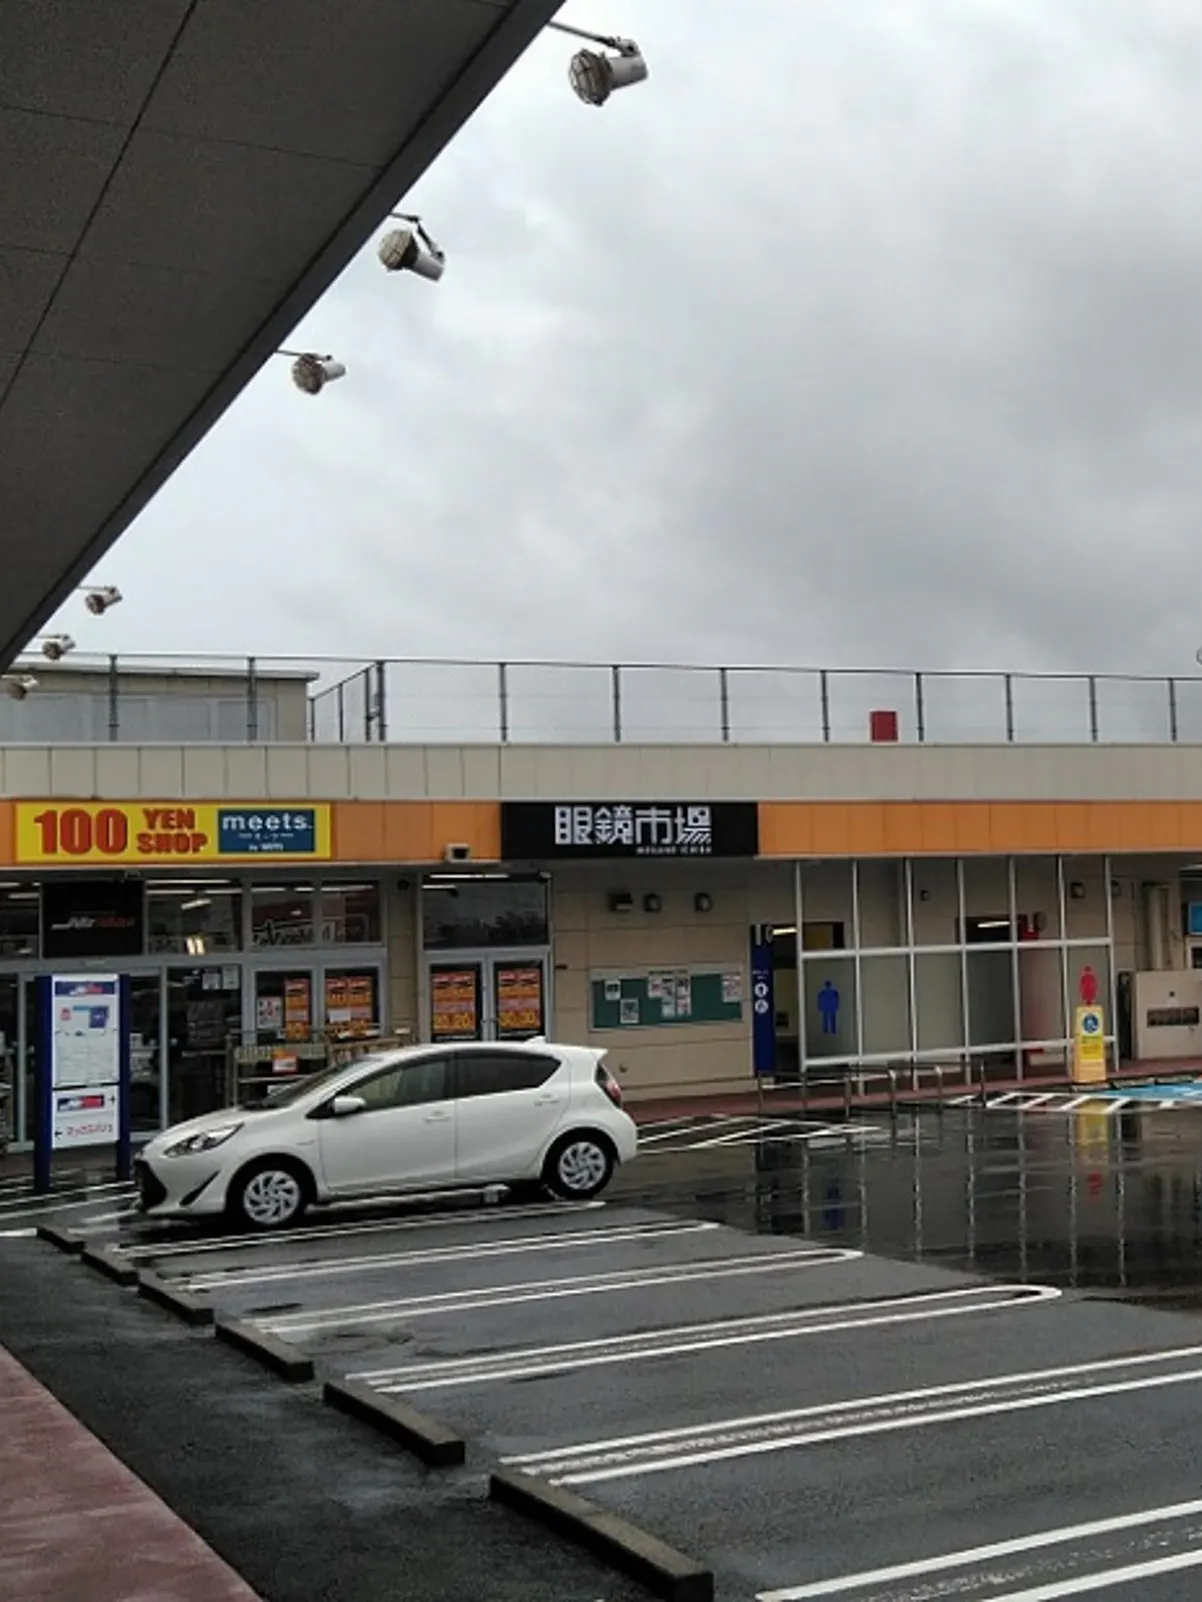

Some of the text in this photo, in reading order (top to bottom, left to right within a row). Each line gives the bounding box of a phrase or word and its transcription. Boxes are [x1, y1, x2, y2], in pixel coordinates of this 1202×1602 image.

[33, 808, 128, 855] 100
[142, 808, 196, 830] YEN
[554, 804, 712, 845] 眼鏡市場
[136, 832, 209, 855] SHOP
